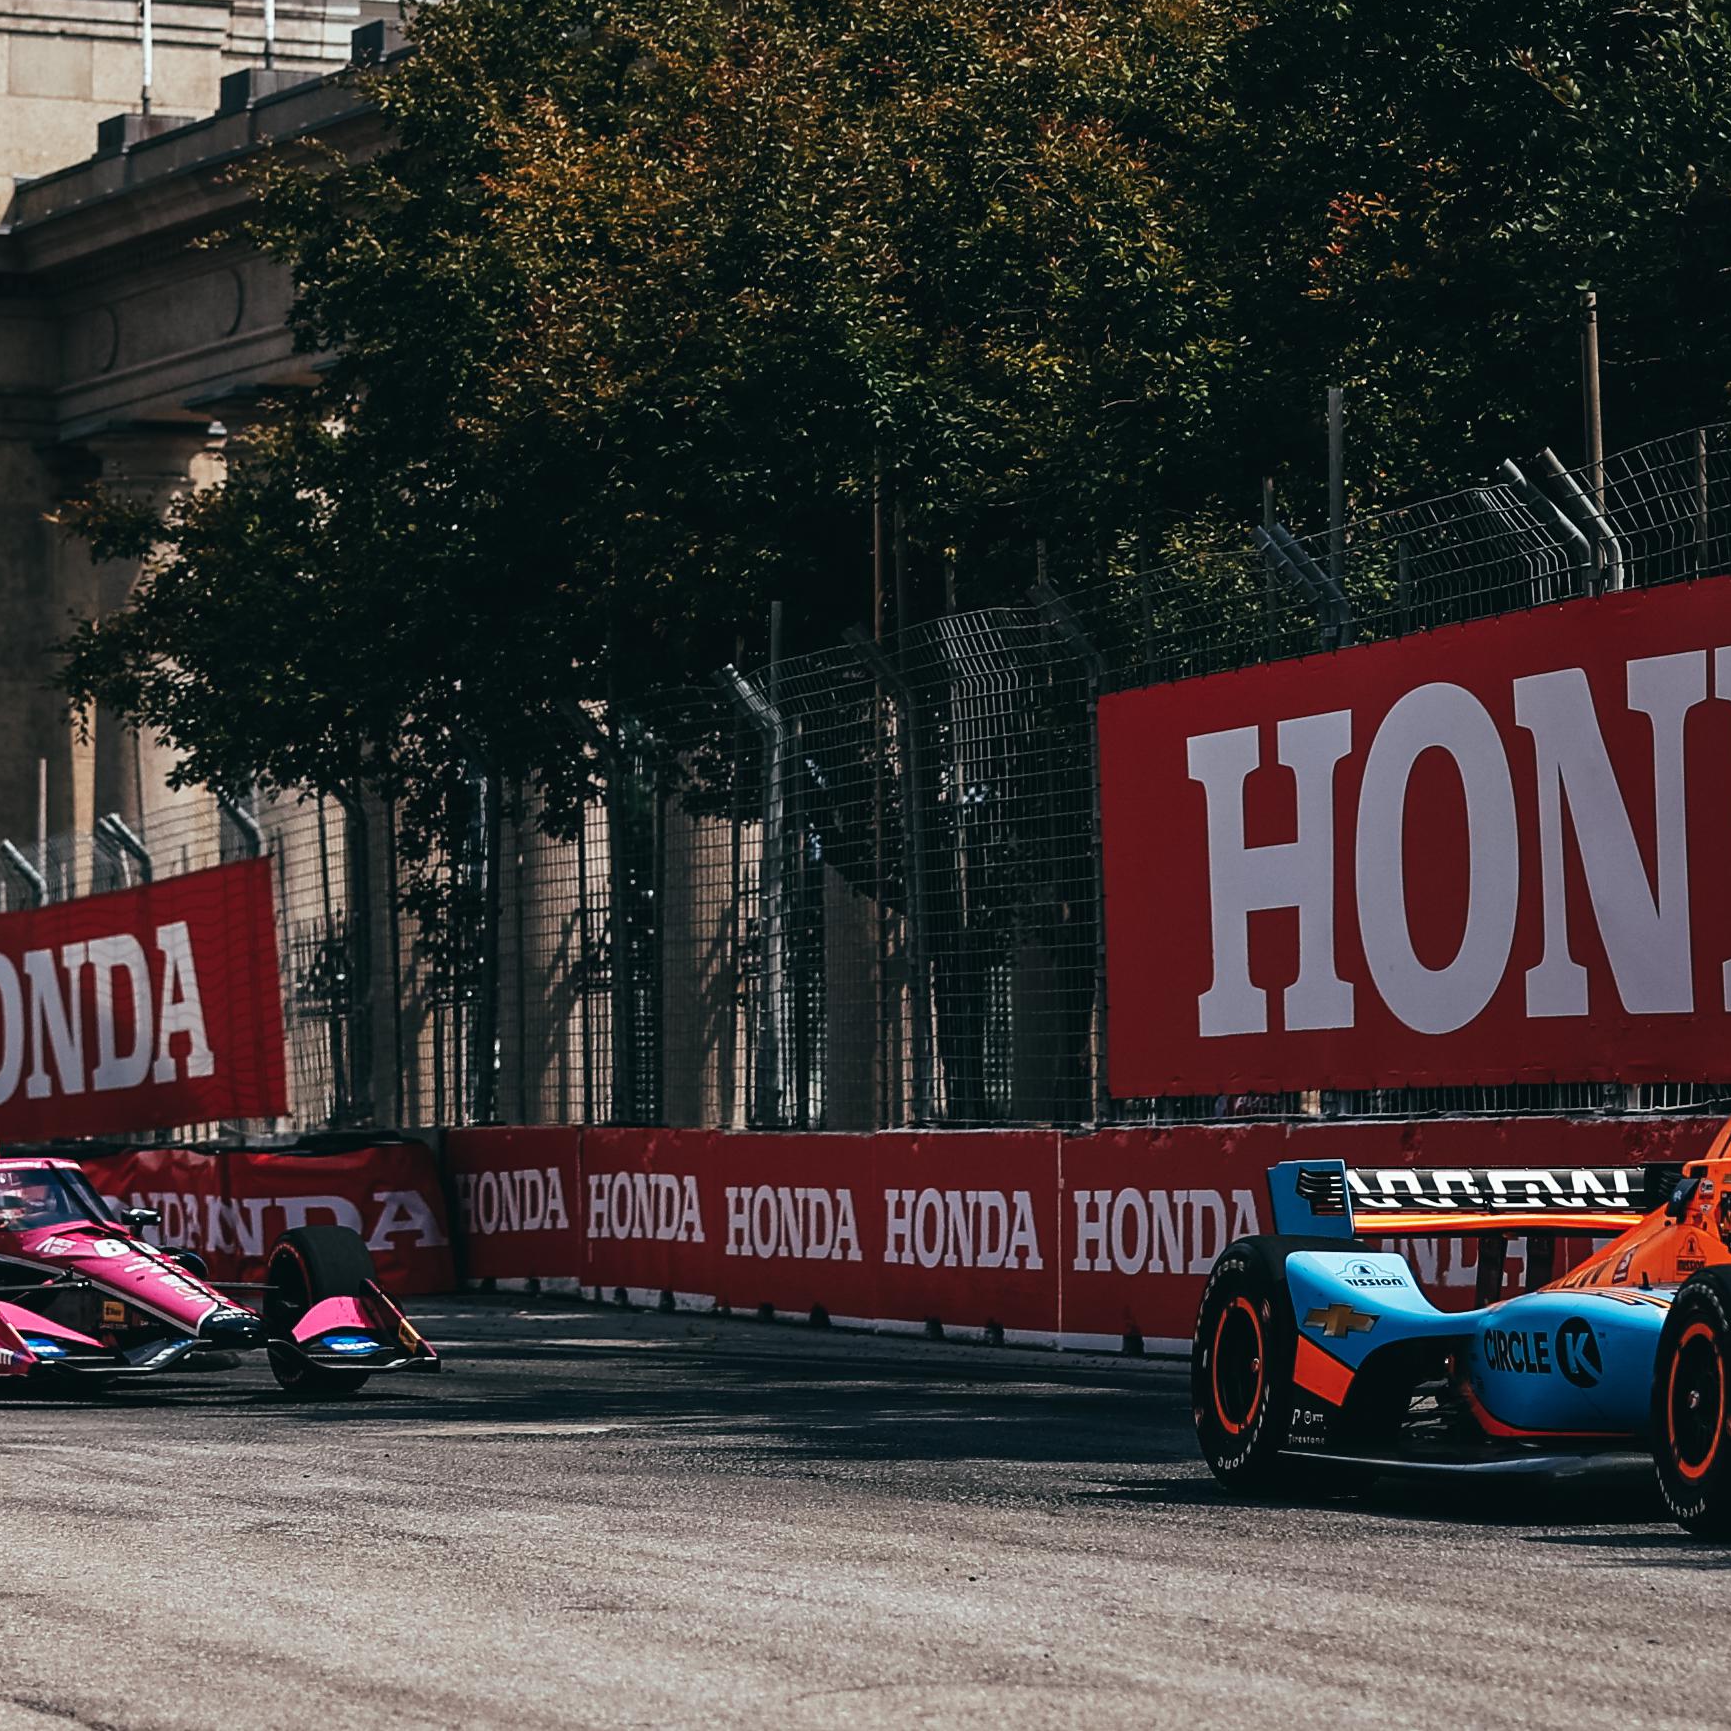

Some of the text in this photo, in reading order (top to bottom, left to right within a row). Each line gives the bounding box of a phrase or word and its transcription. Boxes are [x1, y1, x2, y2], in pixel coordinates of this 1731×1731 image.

[455, 1167, 569, 1235] HONDA
[588, 1172, 705, 1243] HONDA
[725, 1185, 862, 1261] HONDA
[883, 1188, 1043, 1270] HONDA
[1073, 1187, 1261, 1274] HONDA
[1483, 1328, 1552, 1374] CIRCLE
[1562, 1328, 1604, 1382] K
